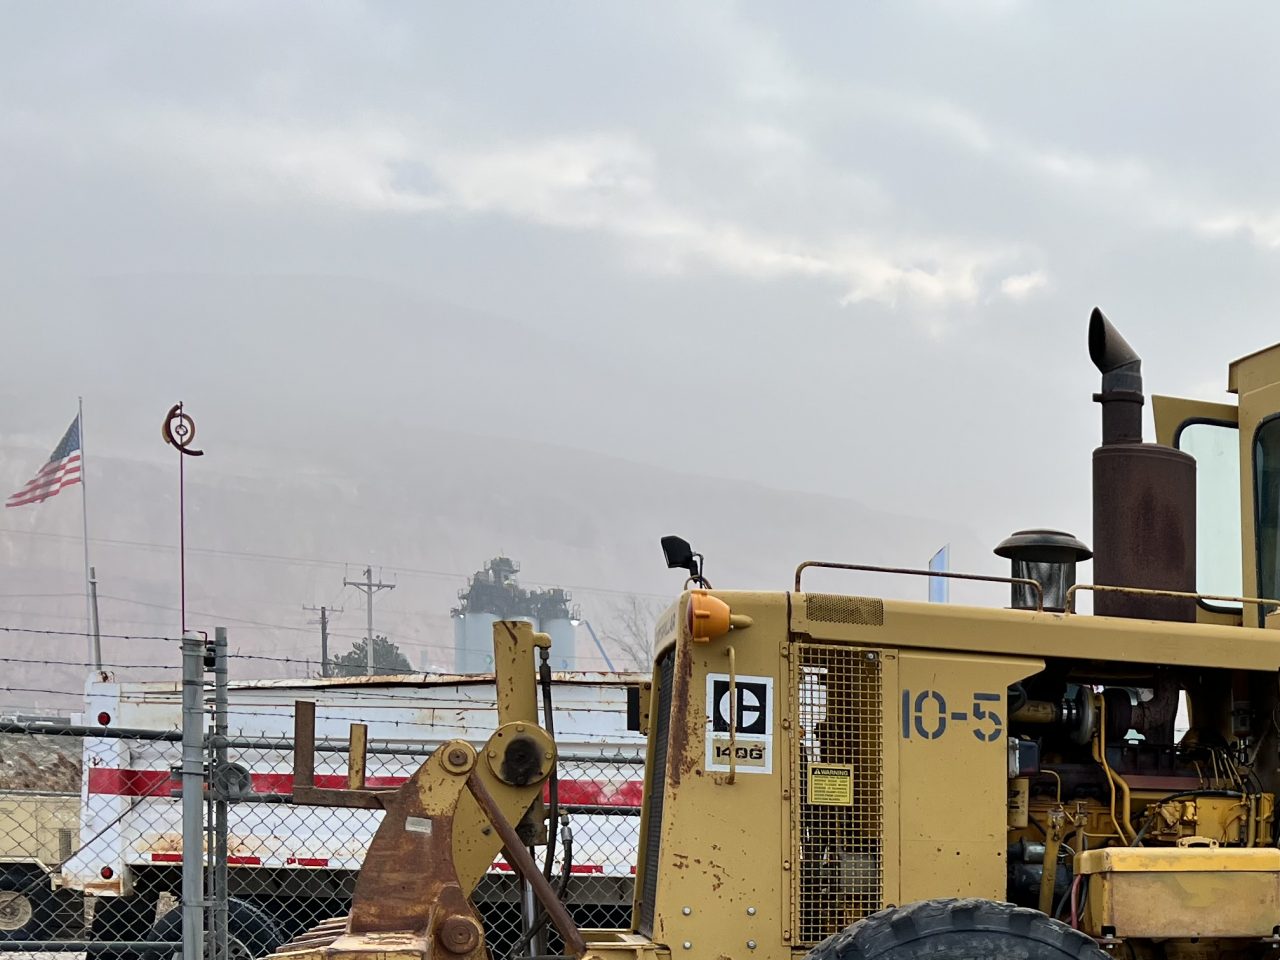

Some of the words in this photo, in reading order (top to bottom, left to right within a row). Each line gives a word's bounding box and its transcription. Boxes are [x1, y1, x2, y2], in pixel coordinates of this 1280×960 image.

[902, 689, 1002, 742] 10-5
[715, 746, 763, 760] 140G
[820, 769, 849, 777] WARNING
